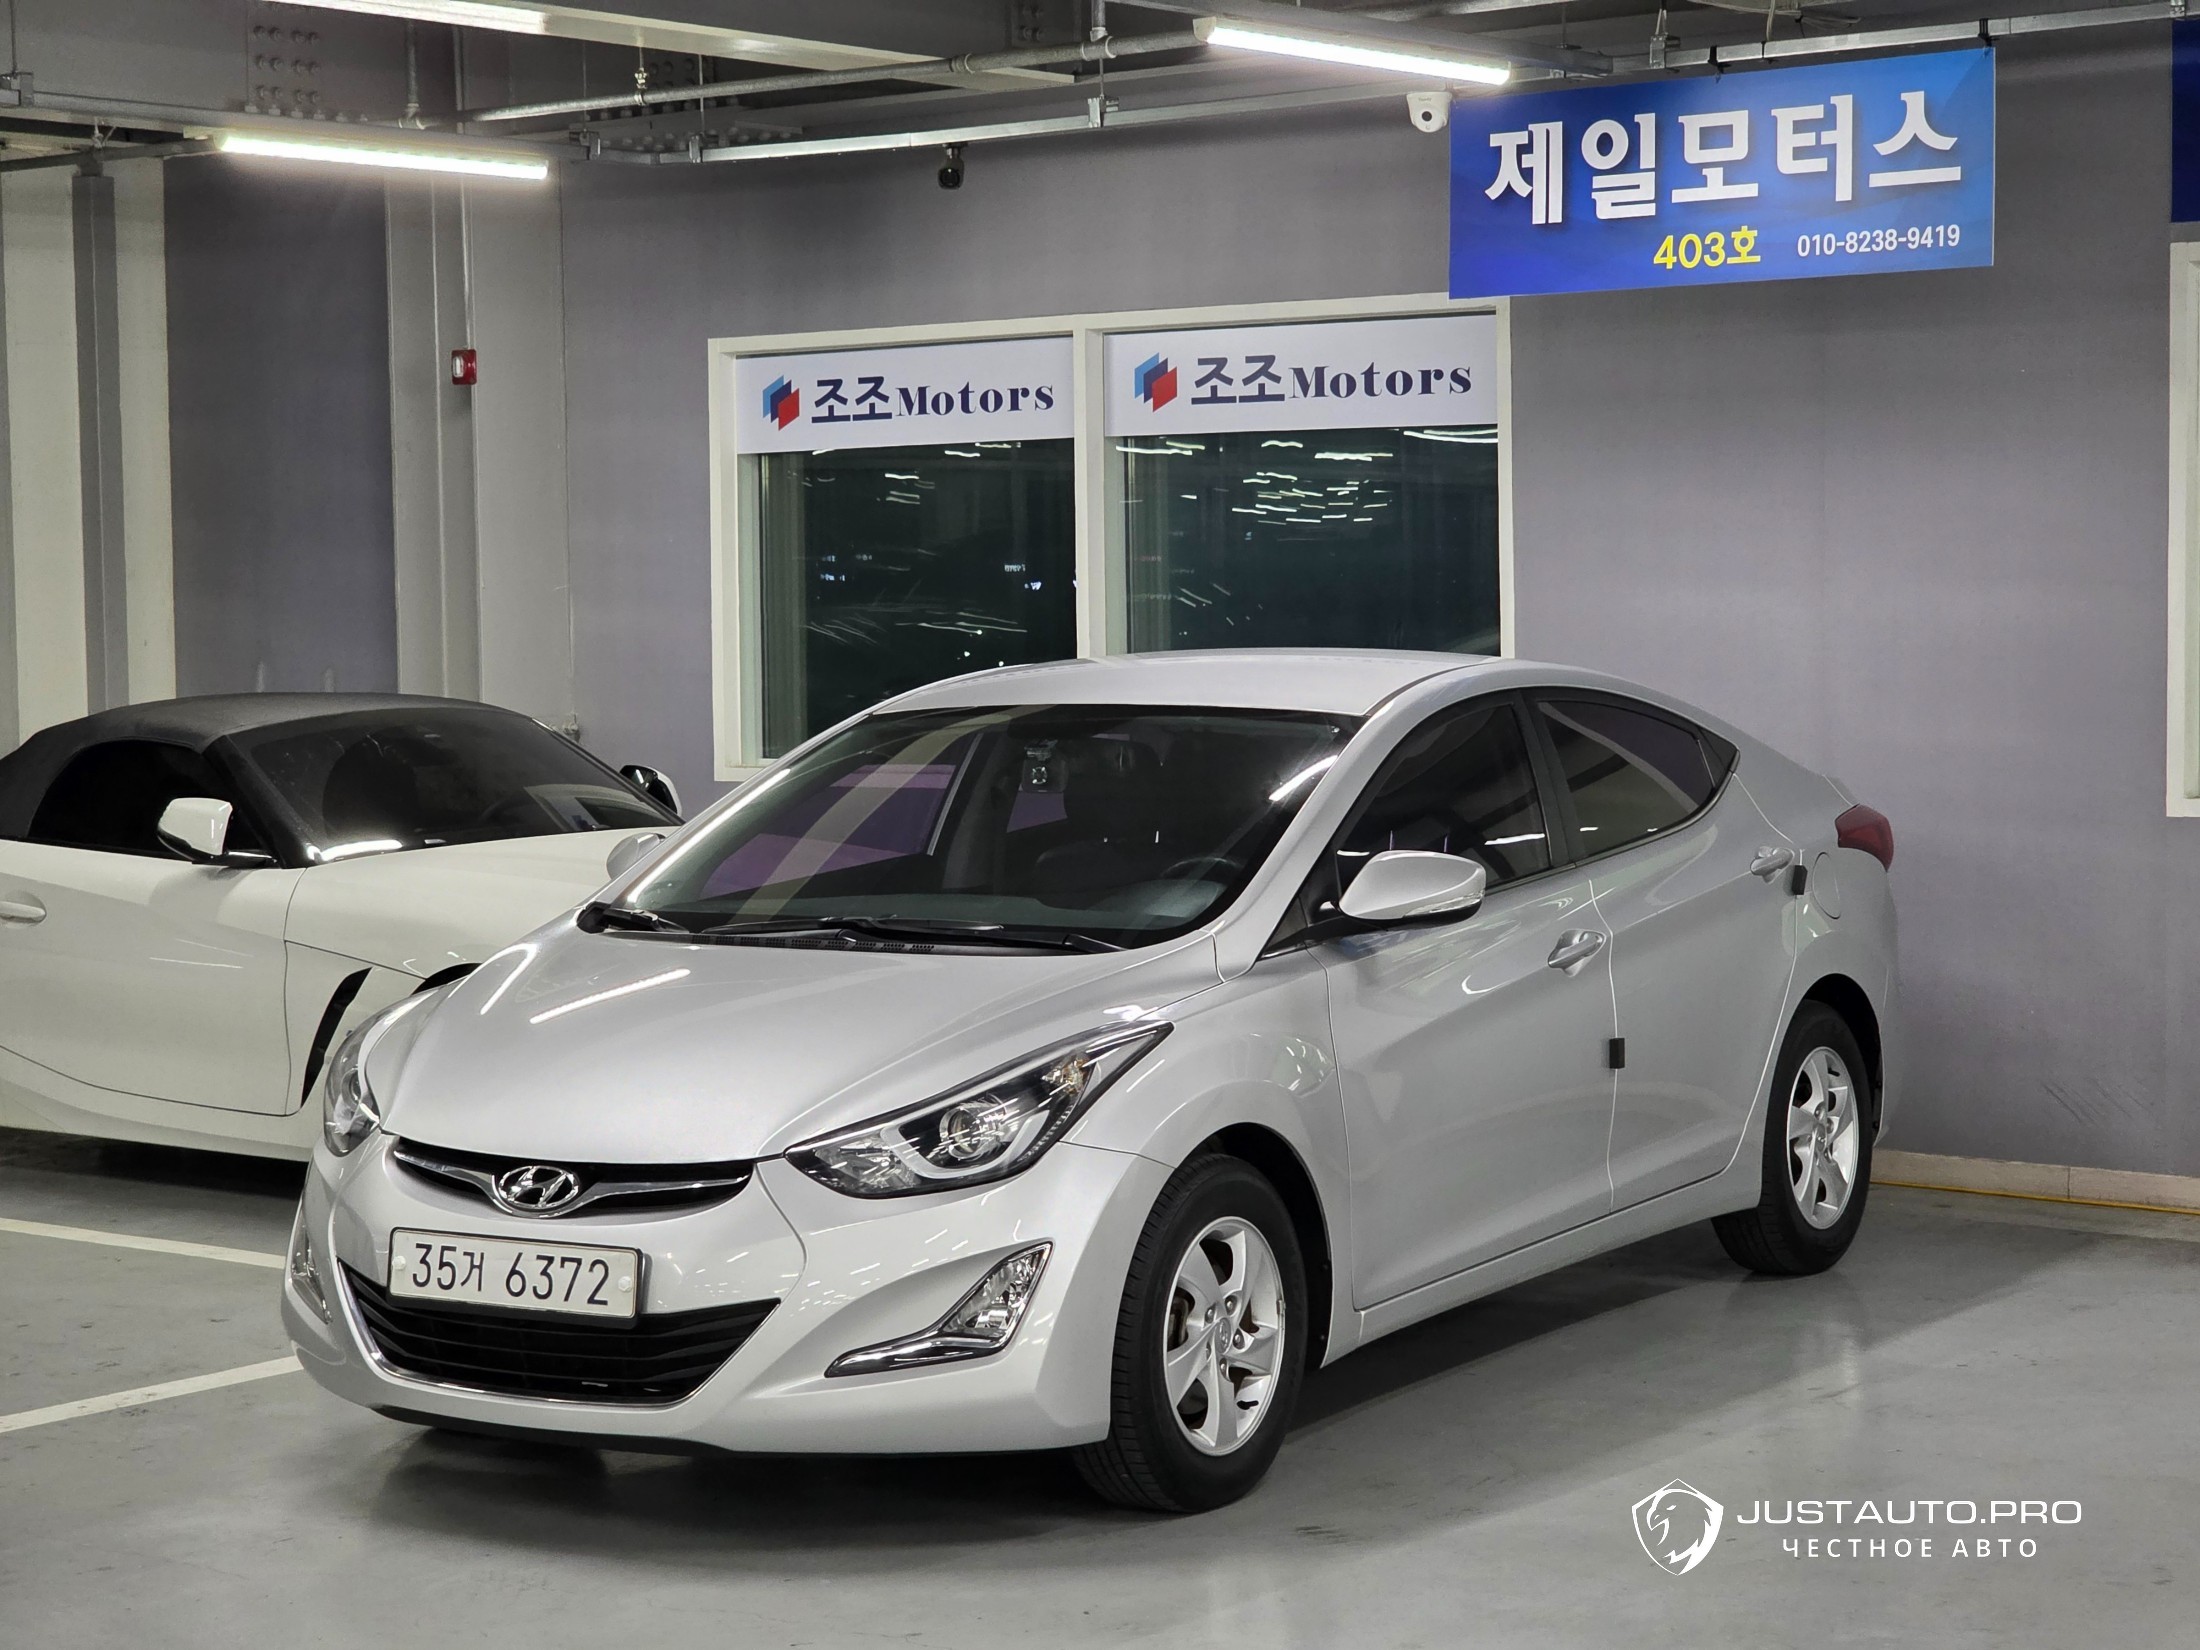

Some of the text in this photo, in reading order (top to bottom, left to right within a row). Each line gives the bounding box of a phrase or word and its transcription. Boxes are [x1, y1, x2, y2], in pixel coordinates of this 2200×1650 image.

[1485, 90, 1962, 225] 제일모터스
[1653, 224, 1961, 269] 403호 010-8238-9419
[505, 1252, 610, 1305] 6372
